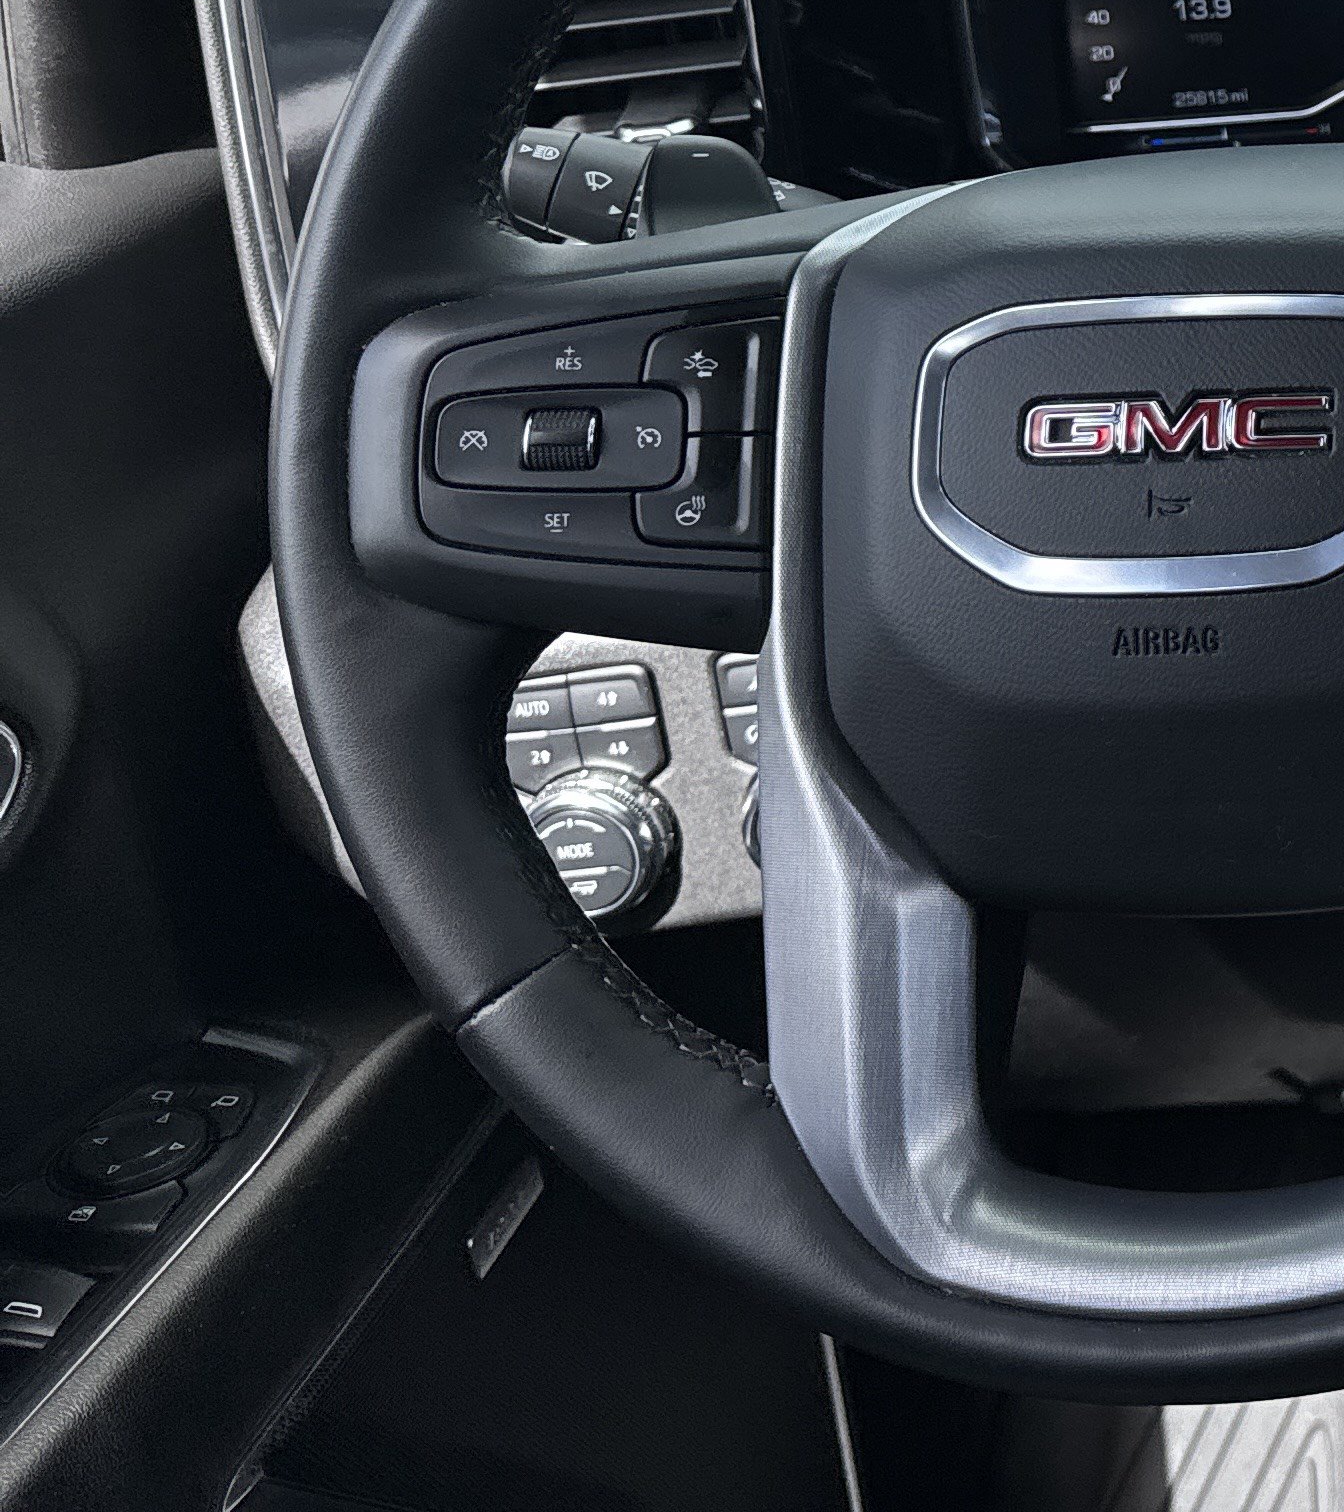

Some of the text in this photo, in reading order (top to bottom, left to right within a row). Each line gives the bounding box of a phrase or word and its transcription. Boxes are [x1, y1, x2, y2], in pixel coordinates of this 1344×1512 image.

[1085, 9, 1110, 26] 40
[1089, 45, 1115, 62] 20
[555, 356, 583, 371] RES
[1024, 395, 1331, 459] GMC
[544, 513, 570, 528] SET
[1112, 626, 1220, 658] AIRBAG
[514, 698, 550, 718] AUTO
[556, 841, 595, 859] MODE
